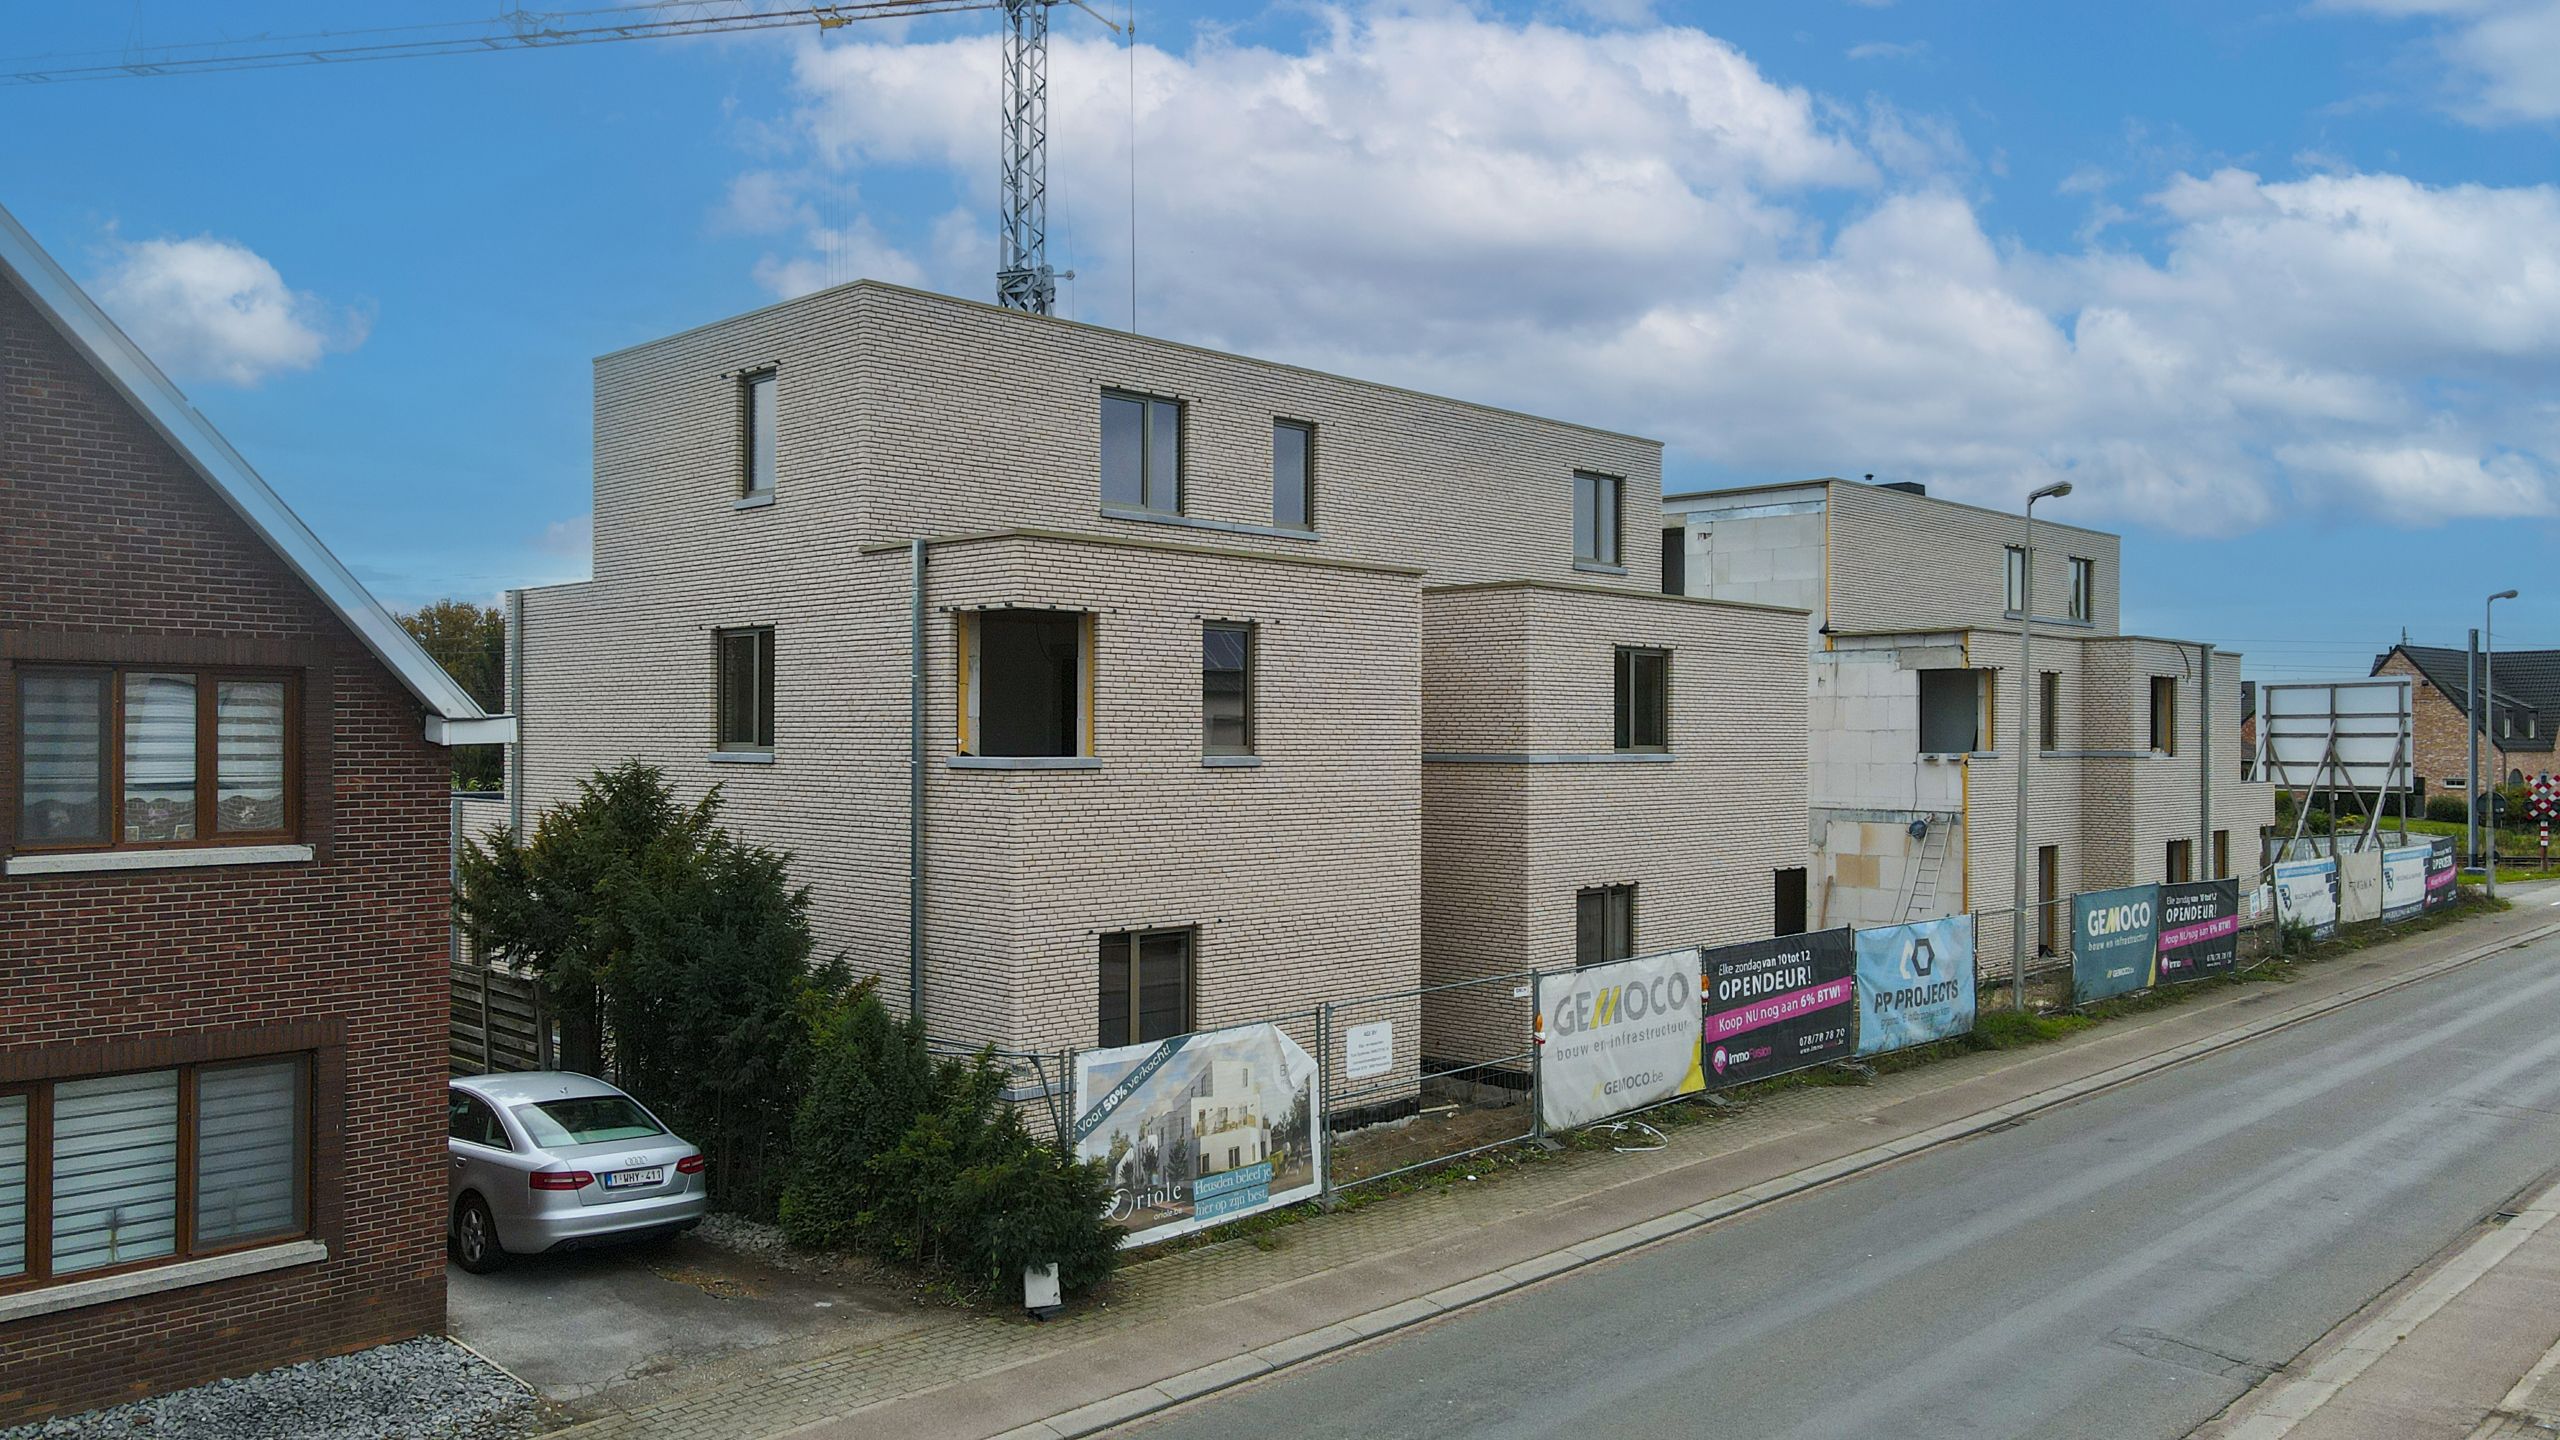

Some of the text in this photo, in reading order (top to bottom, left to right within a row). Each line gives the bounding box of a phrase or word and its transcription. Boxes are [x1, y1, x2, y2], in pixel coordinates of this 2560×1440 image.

[2088, 901, 2151, 937] GEMOCO
[2166, 903, 2217, 923] OPENDEUR!
[1718, 950, 1811, 976] Elke zondag van 10 tot 12
[1719, 965, 1812, 1001] OPENDEUR!
[1874, 979, 1959, 1014] PP PROJECTS
[1553, 971, 1690, 1037] GEMOCO
[1718, 985, 1841, 1033] Koop NU nog aan 6% BTW!
[1556, 1043, 1590, 1062] bouw
[1610, 1019, 1688, 1049] infrastructuur
[1825, 1029, 1834, 1041] 78
[1835, 1027, 1845, 1039] 70
[1077, 1043, 1172, 1133] Voor 50% verkocht!
[1603, 1069, 1664, 1095] GEMOCO.be
[1194, 1175, 1234, 1195] Heusden
[1235, 1166, 1261, 1184] beleef
[1110, 1182, 1182, 1221] Oriole
[1195, 1189, 1268, 1217] hier op zijn best.
